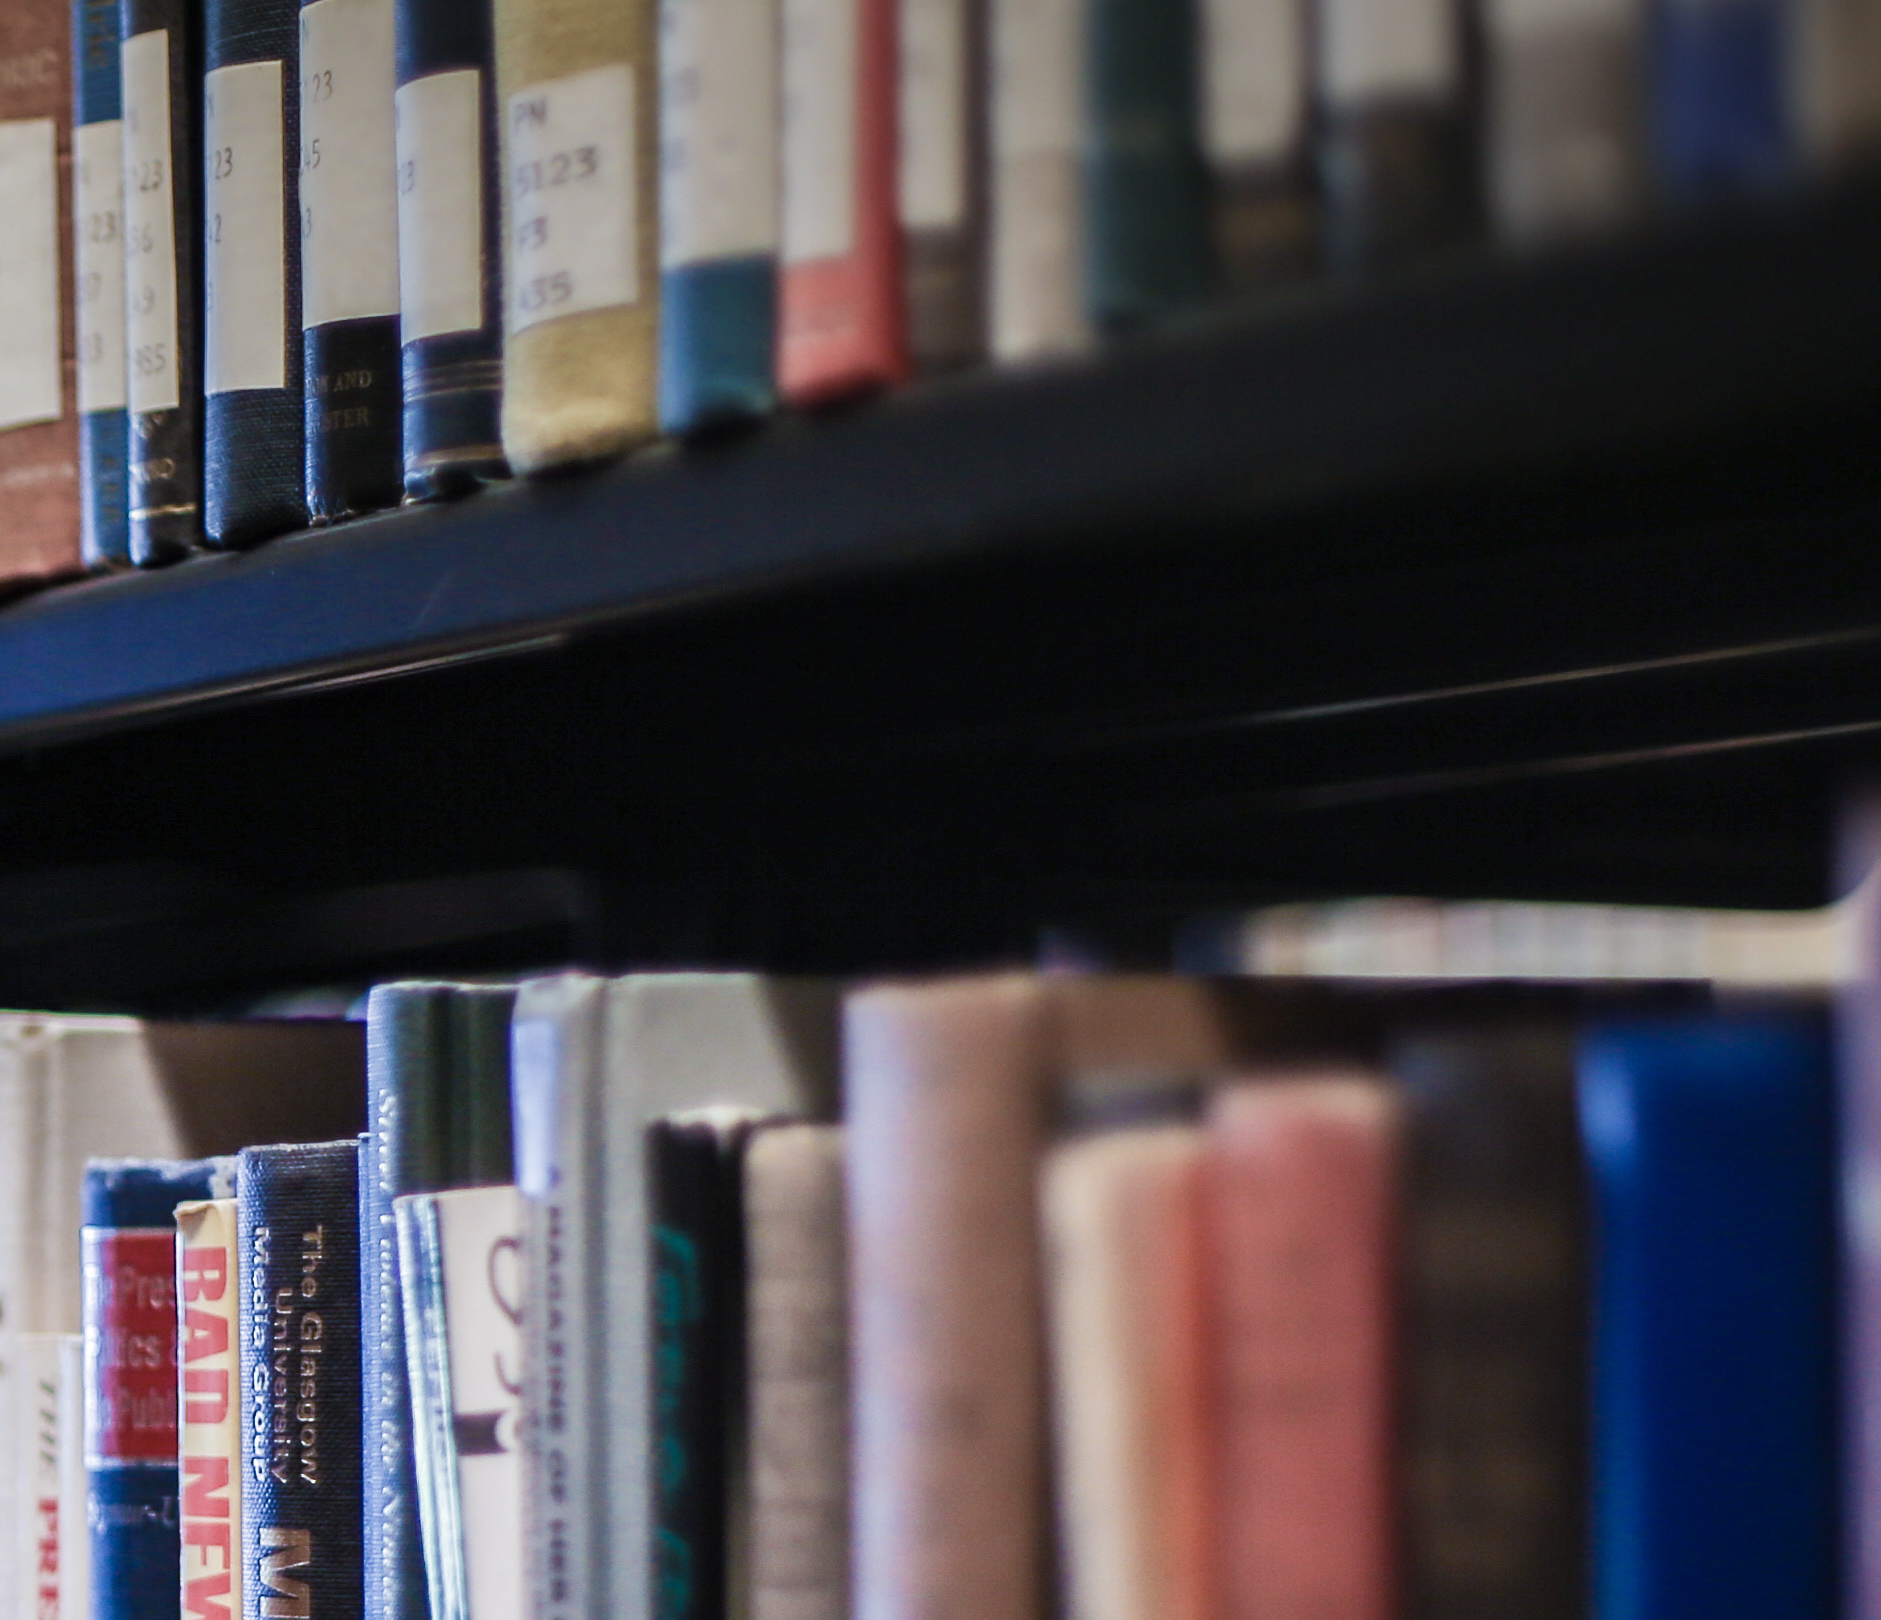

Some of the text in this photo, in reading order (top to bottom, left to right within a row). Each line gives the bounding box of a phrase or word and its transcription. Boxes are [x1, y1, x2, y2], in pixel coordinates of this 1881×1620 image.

[514, 145, 599, 200] 5123
[183, 1245, 230, 1425] BAD
[251, 1225, 272, 1484] Media Group
[271, 1287, 295, 1485] University
[295, 1225, 324, 1486] The Glasgow
